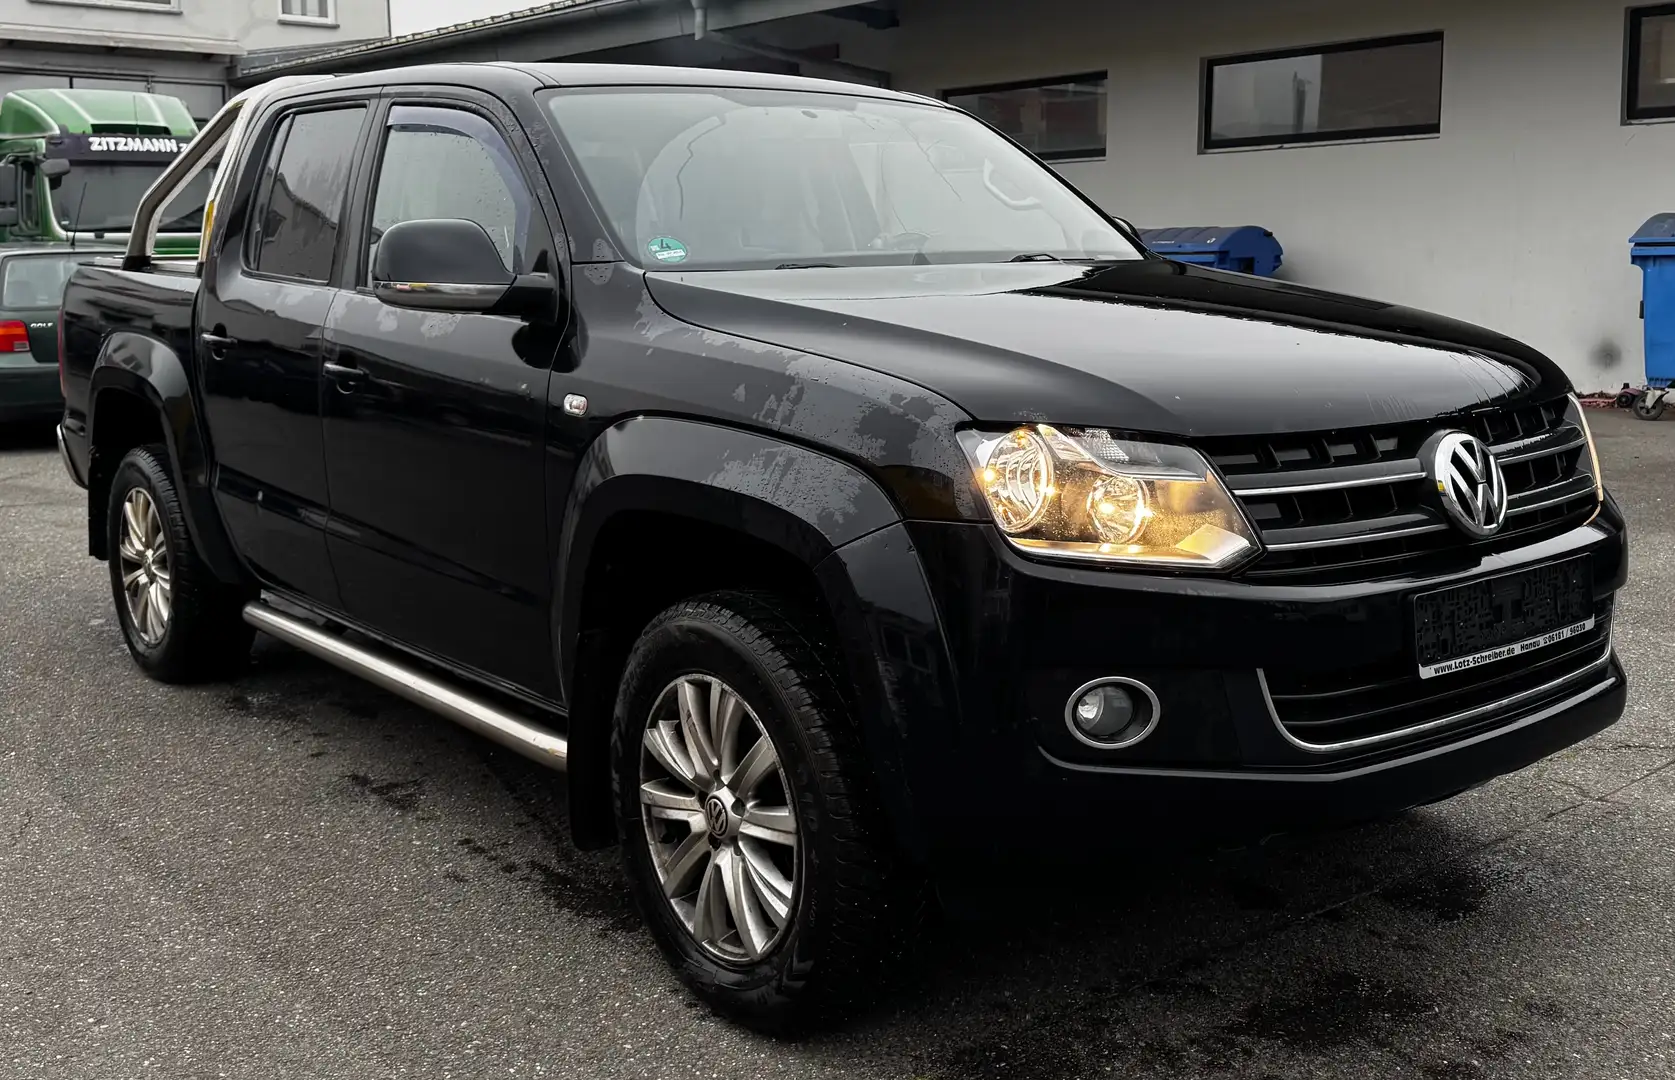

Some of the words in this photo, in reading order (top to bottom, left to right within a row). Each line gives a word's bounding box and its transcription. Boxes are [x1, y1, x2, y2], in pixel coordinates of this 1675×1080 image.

[88, 136, 178, 152] ZITZMANN
[1433, 647, 1515, 675] www.Lotz-Schreiber.de
[1520, 638, 1541, 652] Hanau
